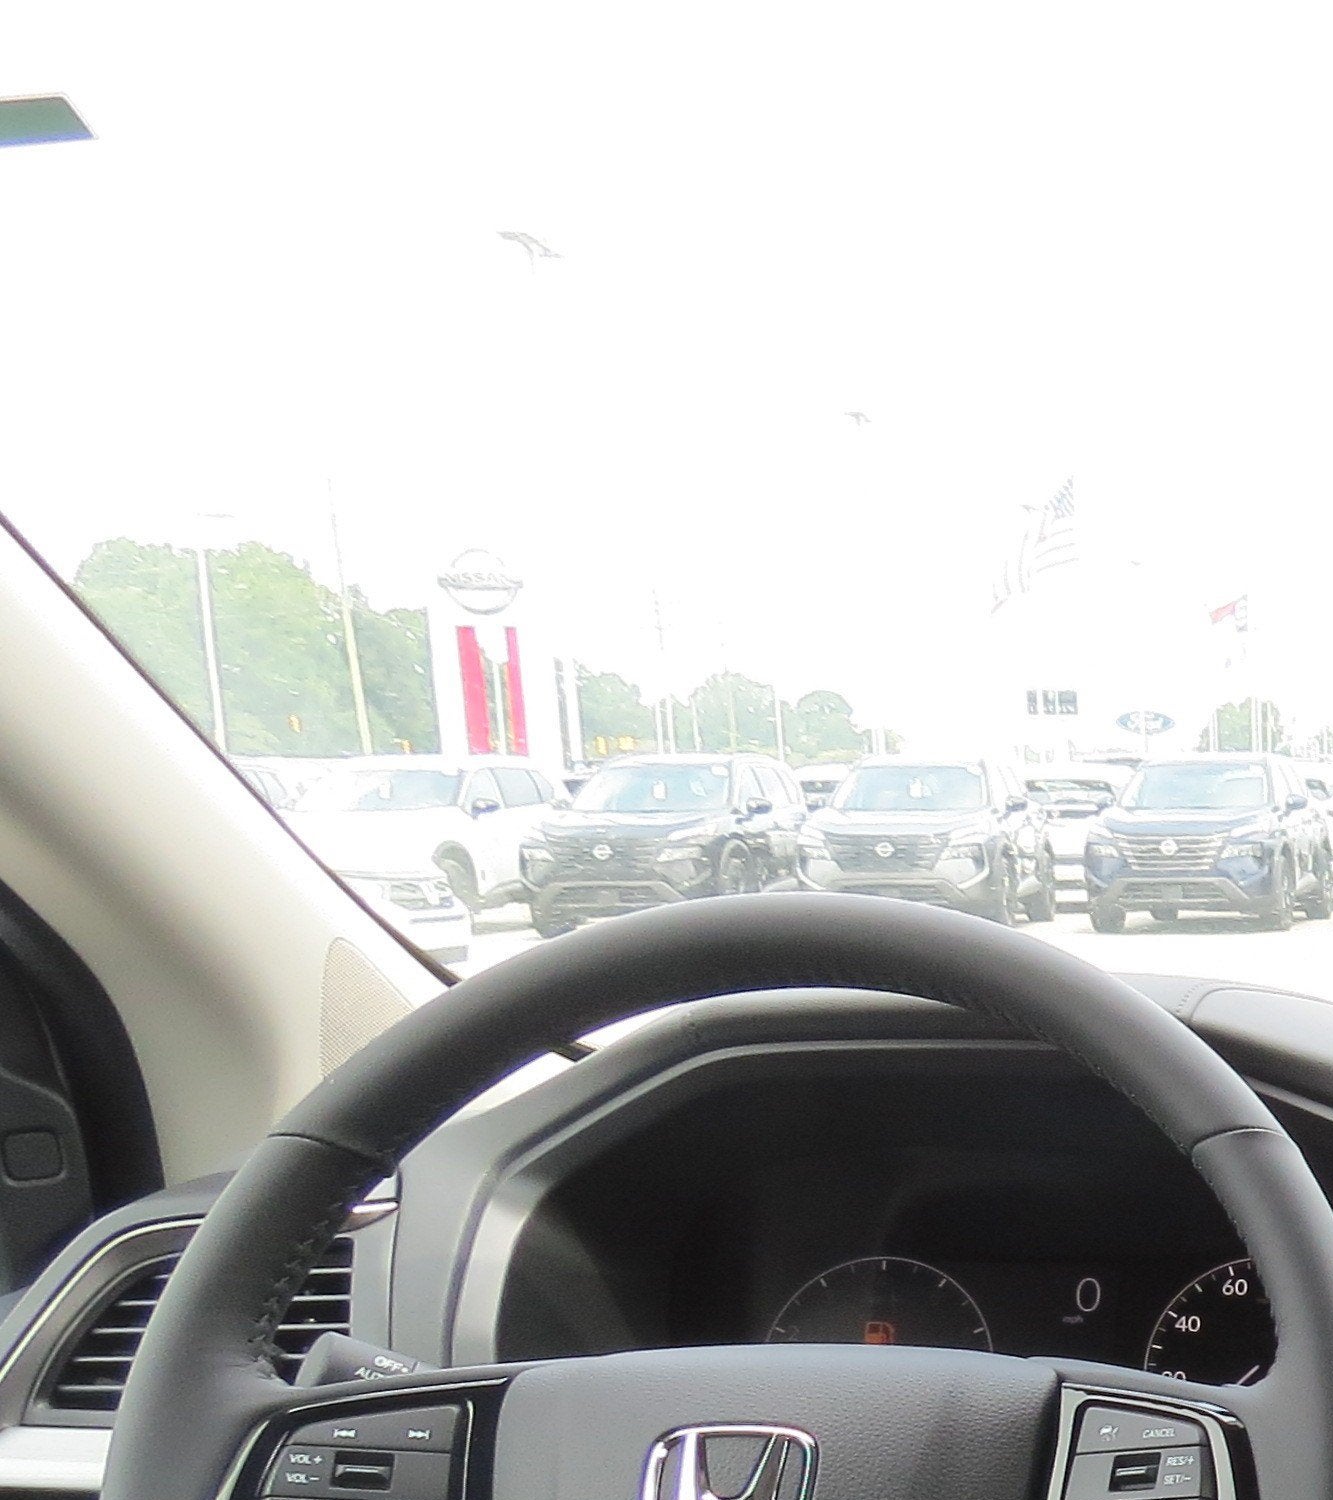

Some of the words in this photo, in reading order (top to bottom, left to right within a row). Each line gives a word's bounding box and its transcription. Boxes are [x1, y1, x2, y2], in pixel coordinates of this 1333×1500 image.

[1076, 1277, 1101, 1312] 0
[1222, 1278, 1248, 1296] 60
[1174, 1315, 1201, 1333] 40
[374, 1355, 404, 1372] OFF
[1142, 1427, 1176, 1439] CANCEL
